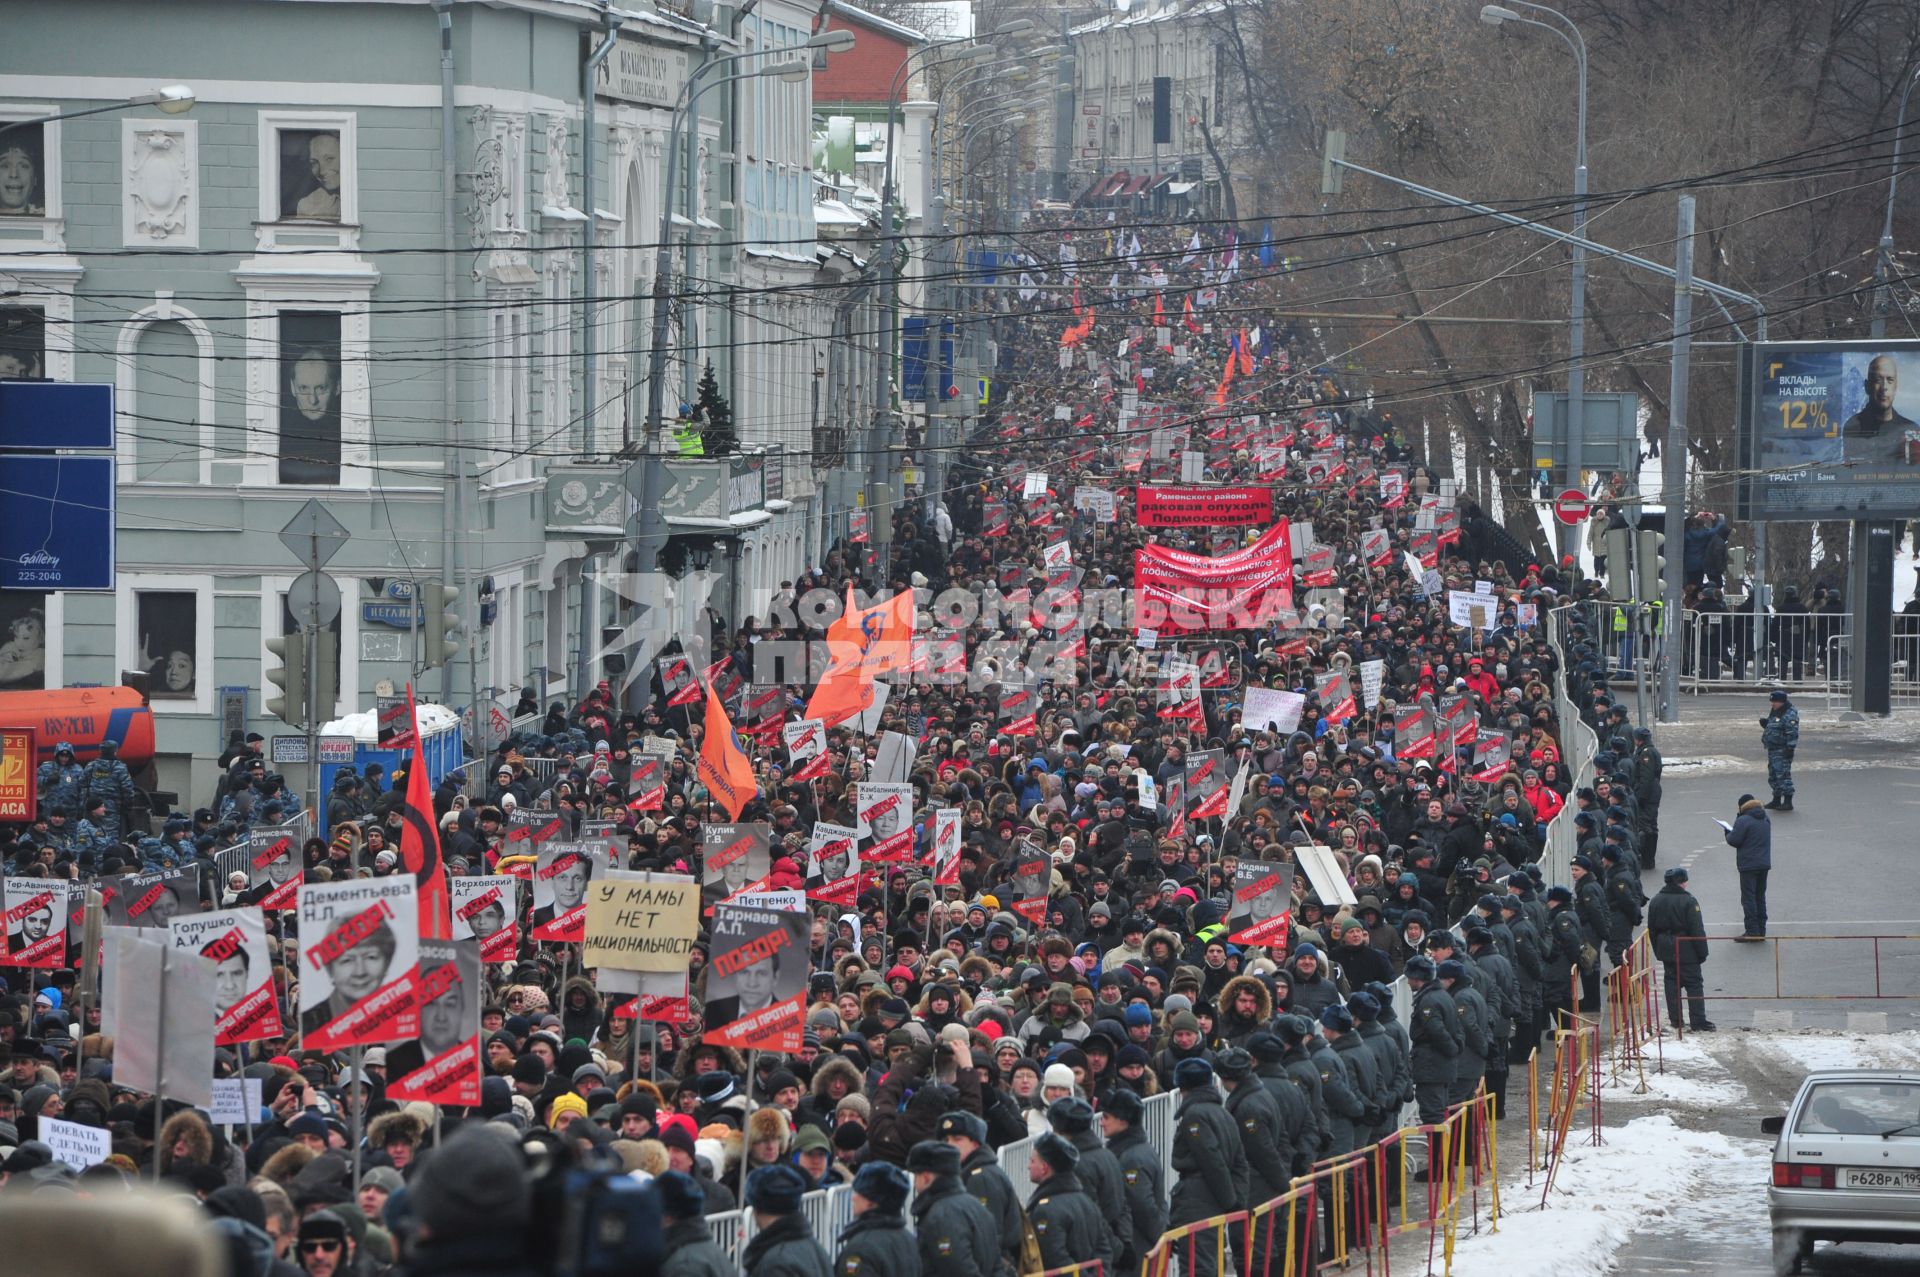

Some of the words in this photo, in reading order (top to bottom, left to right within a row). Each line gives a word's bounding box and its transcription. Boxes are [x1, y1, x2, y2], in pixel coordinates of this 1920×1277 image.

[1779, 375, 1817, 387] ВКЛАДЫ
[1779, 386, 1792, 396] НА
[1794, 386, 1827, 396] ВЫСОТЕ
[1779, 400, 1828, 430] 12%
[1769, 474, 1799, 482] ТРАСТ
[1817, 472, 1835, 481] Банк
[1214, 493, 1247, 501] района
[1141, 503, 1203, 512] раковая
[1206, 502, 1268, 513] опухоль
[1152, 512, 1258, 523] Подмосковья!
[19, 553, 60, 568] Gallery
[18, 571, 61, 581] 225-2040
[395, 583, 412, 596] 29
[321, 744, 351, 752] КРЕДИТ
[251, 830, 293, 839] Денисенко
[705, 826, 735, 834] Кулик
[706, 835, 724, 843] Г.В.
[869, 843, 887, 857] МАРШ
[886, 832, 910, 849] ПРОТИВ
[545, 842, 578, 852] Жуков
[1238, 862, 1270, 872] Кидяев
[455, 878, 512, 888] Верховский
[1237, 871, 1255, 880] В.Б.
[7, 880, 65, 891] Тер-Аванесов
[833, 877, 855, 890] ПРОТИВ
[303, 883, 411, 905] Дементьева
[454, 888, 472, 897] А.Г.
[601, 886, 616, 902] У
[626, 889, 684, 906] МАМЫ
[6, 890, 56, 923] ПОЗОР!
[616, 910, 661, 928] НЕТ
[717, 905, 779, 925] Тарнаев
[173, 917, 235, 934] Голушко
[547, 917, 571, 933] МАРШ
[715, 924, 747, 936] А.П.
[1241, 927, 1260, 940] МАРШ
[1259, 916, 1285, 932] ПРОТИВ
[175, 935, 205, 948] А.И.
[305, 899, 396, 971] ПОЗОР!
[487, 929, 513, 949] ПРОТИВ
[14, 948, 35, 962] МАРШ
[35, 935, 62, 954] ПРОТИВ
[584, 936, 693, 954] НАЦИОНАЛЬНОСТИ
[712, 927, 792, 979] ПОЗОР!
[234, 988, 271, 1019] ПРОТИВ
[327, 1007, 365, 1039] МАРШ
[363, 977, 413, 1015] ПРОТИВ
[226, 1001, 274, 1040] ПОДЛЕЦОВ
[725, 1018, 757, 1039] МАРШ
[757, 1000, 800, 1027] ПРОТИВ
[744, 1018, 800, 1044] ПОДЛЕЦОВ
[403, 1067, 436, 1092] МАРШ
[435, 1044, 475, 1076] ПРОТИВ
[50, 1122, 99, 1141] ВОЕВАТЬ
[49, 1136, 55, 1144] С
[58, 1138, 101, 1155] ДЕТЬМИ
[1851, 1173, 1900, 1186] Р628РА
